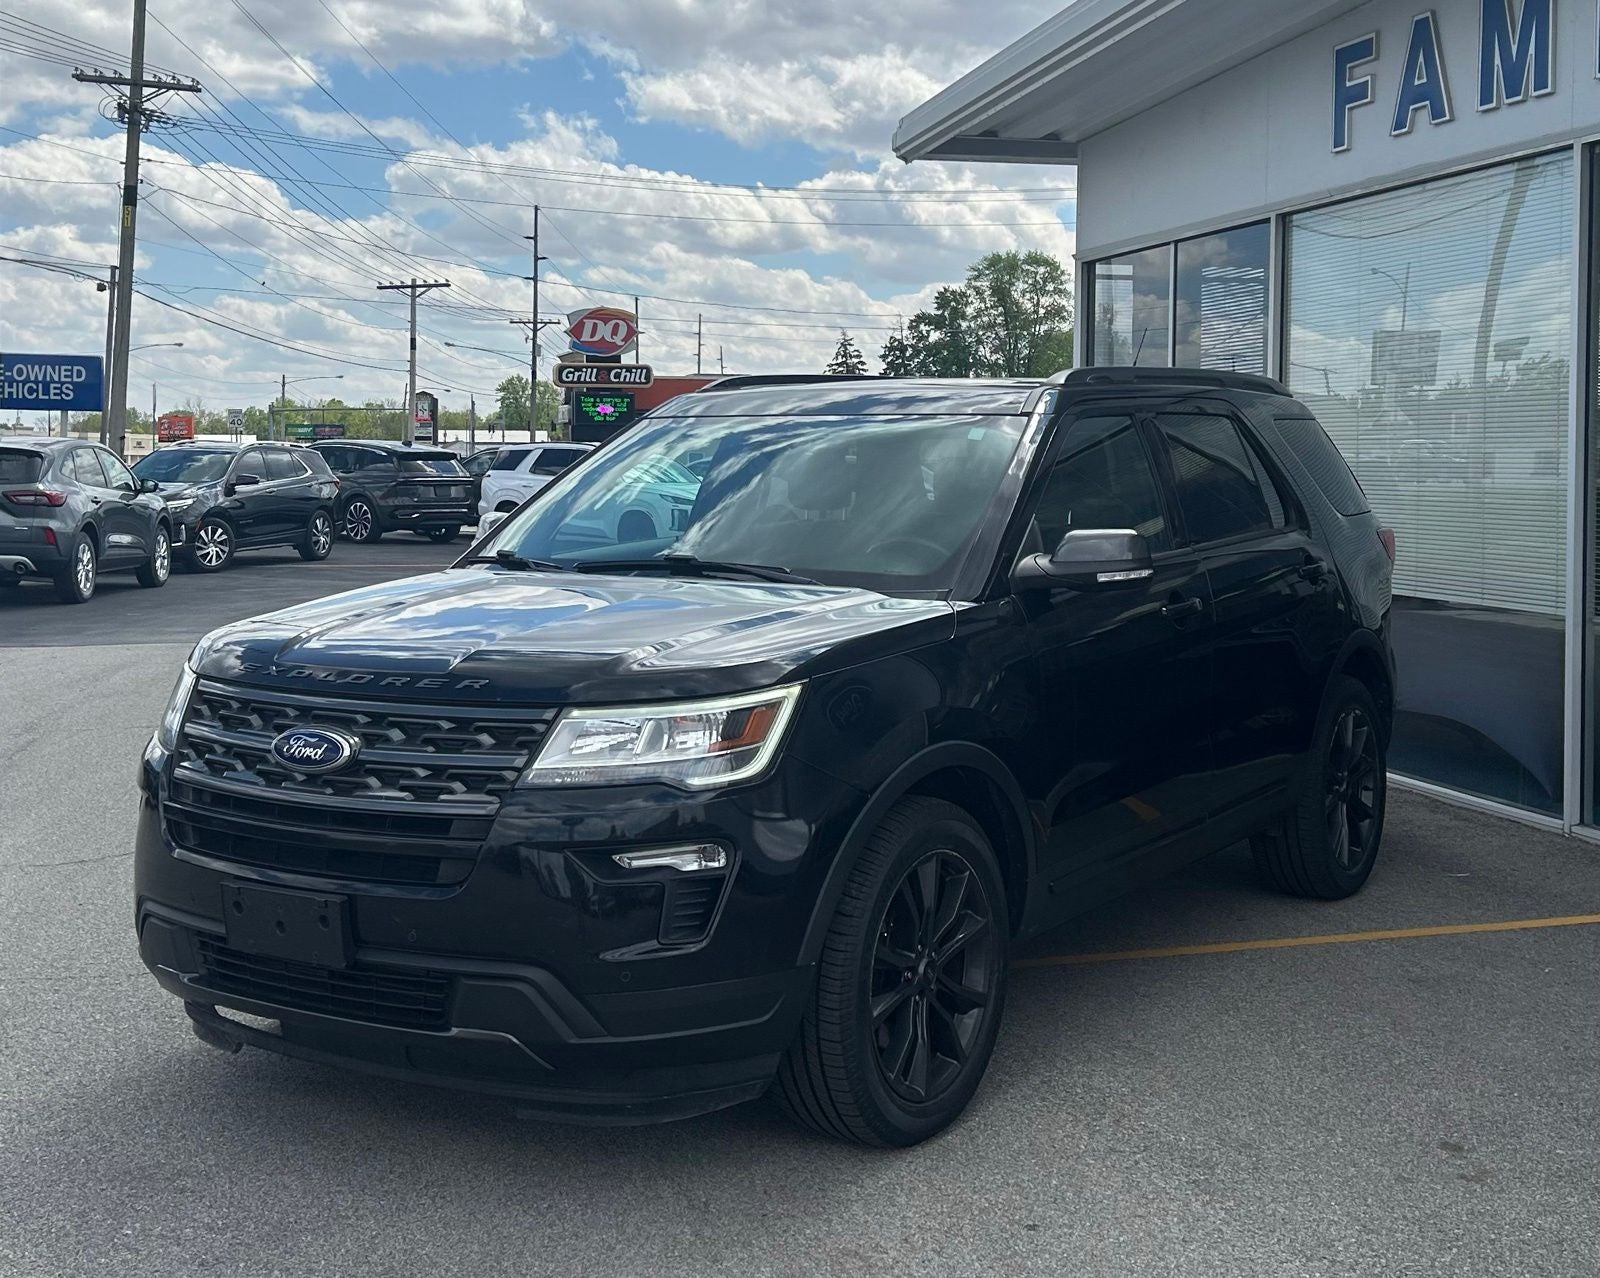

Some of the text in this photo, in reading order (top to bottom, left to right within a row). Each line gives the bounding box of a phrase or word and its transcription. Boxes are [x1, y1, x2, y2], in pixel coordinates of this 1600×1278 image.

[1330, 0, 1600, 153] FAM
[580, 319, 628, 346] DQ
[562, 368, 597, 382] Grill
[610, 368, 647, 383] Chill
[230, 418, 243, 426] 40
[239, 663, 490, 690] EXPLORER
[283, 734, 327, 762] Ford
